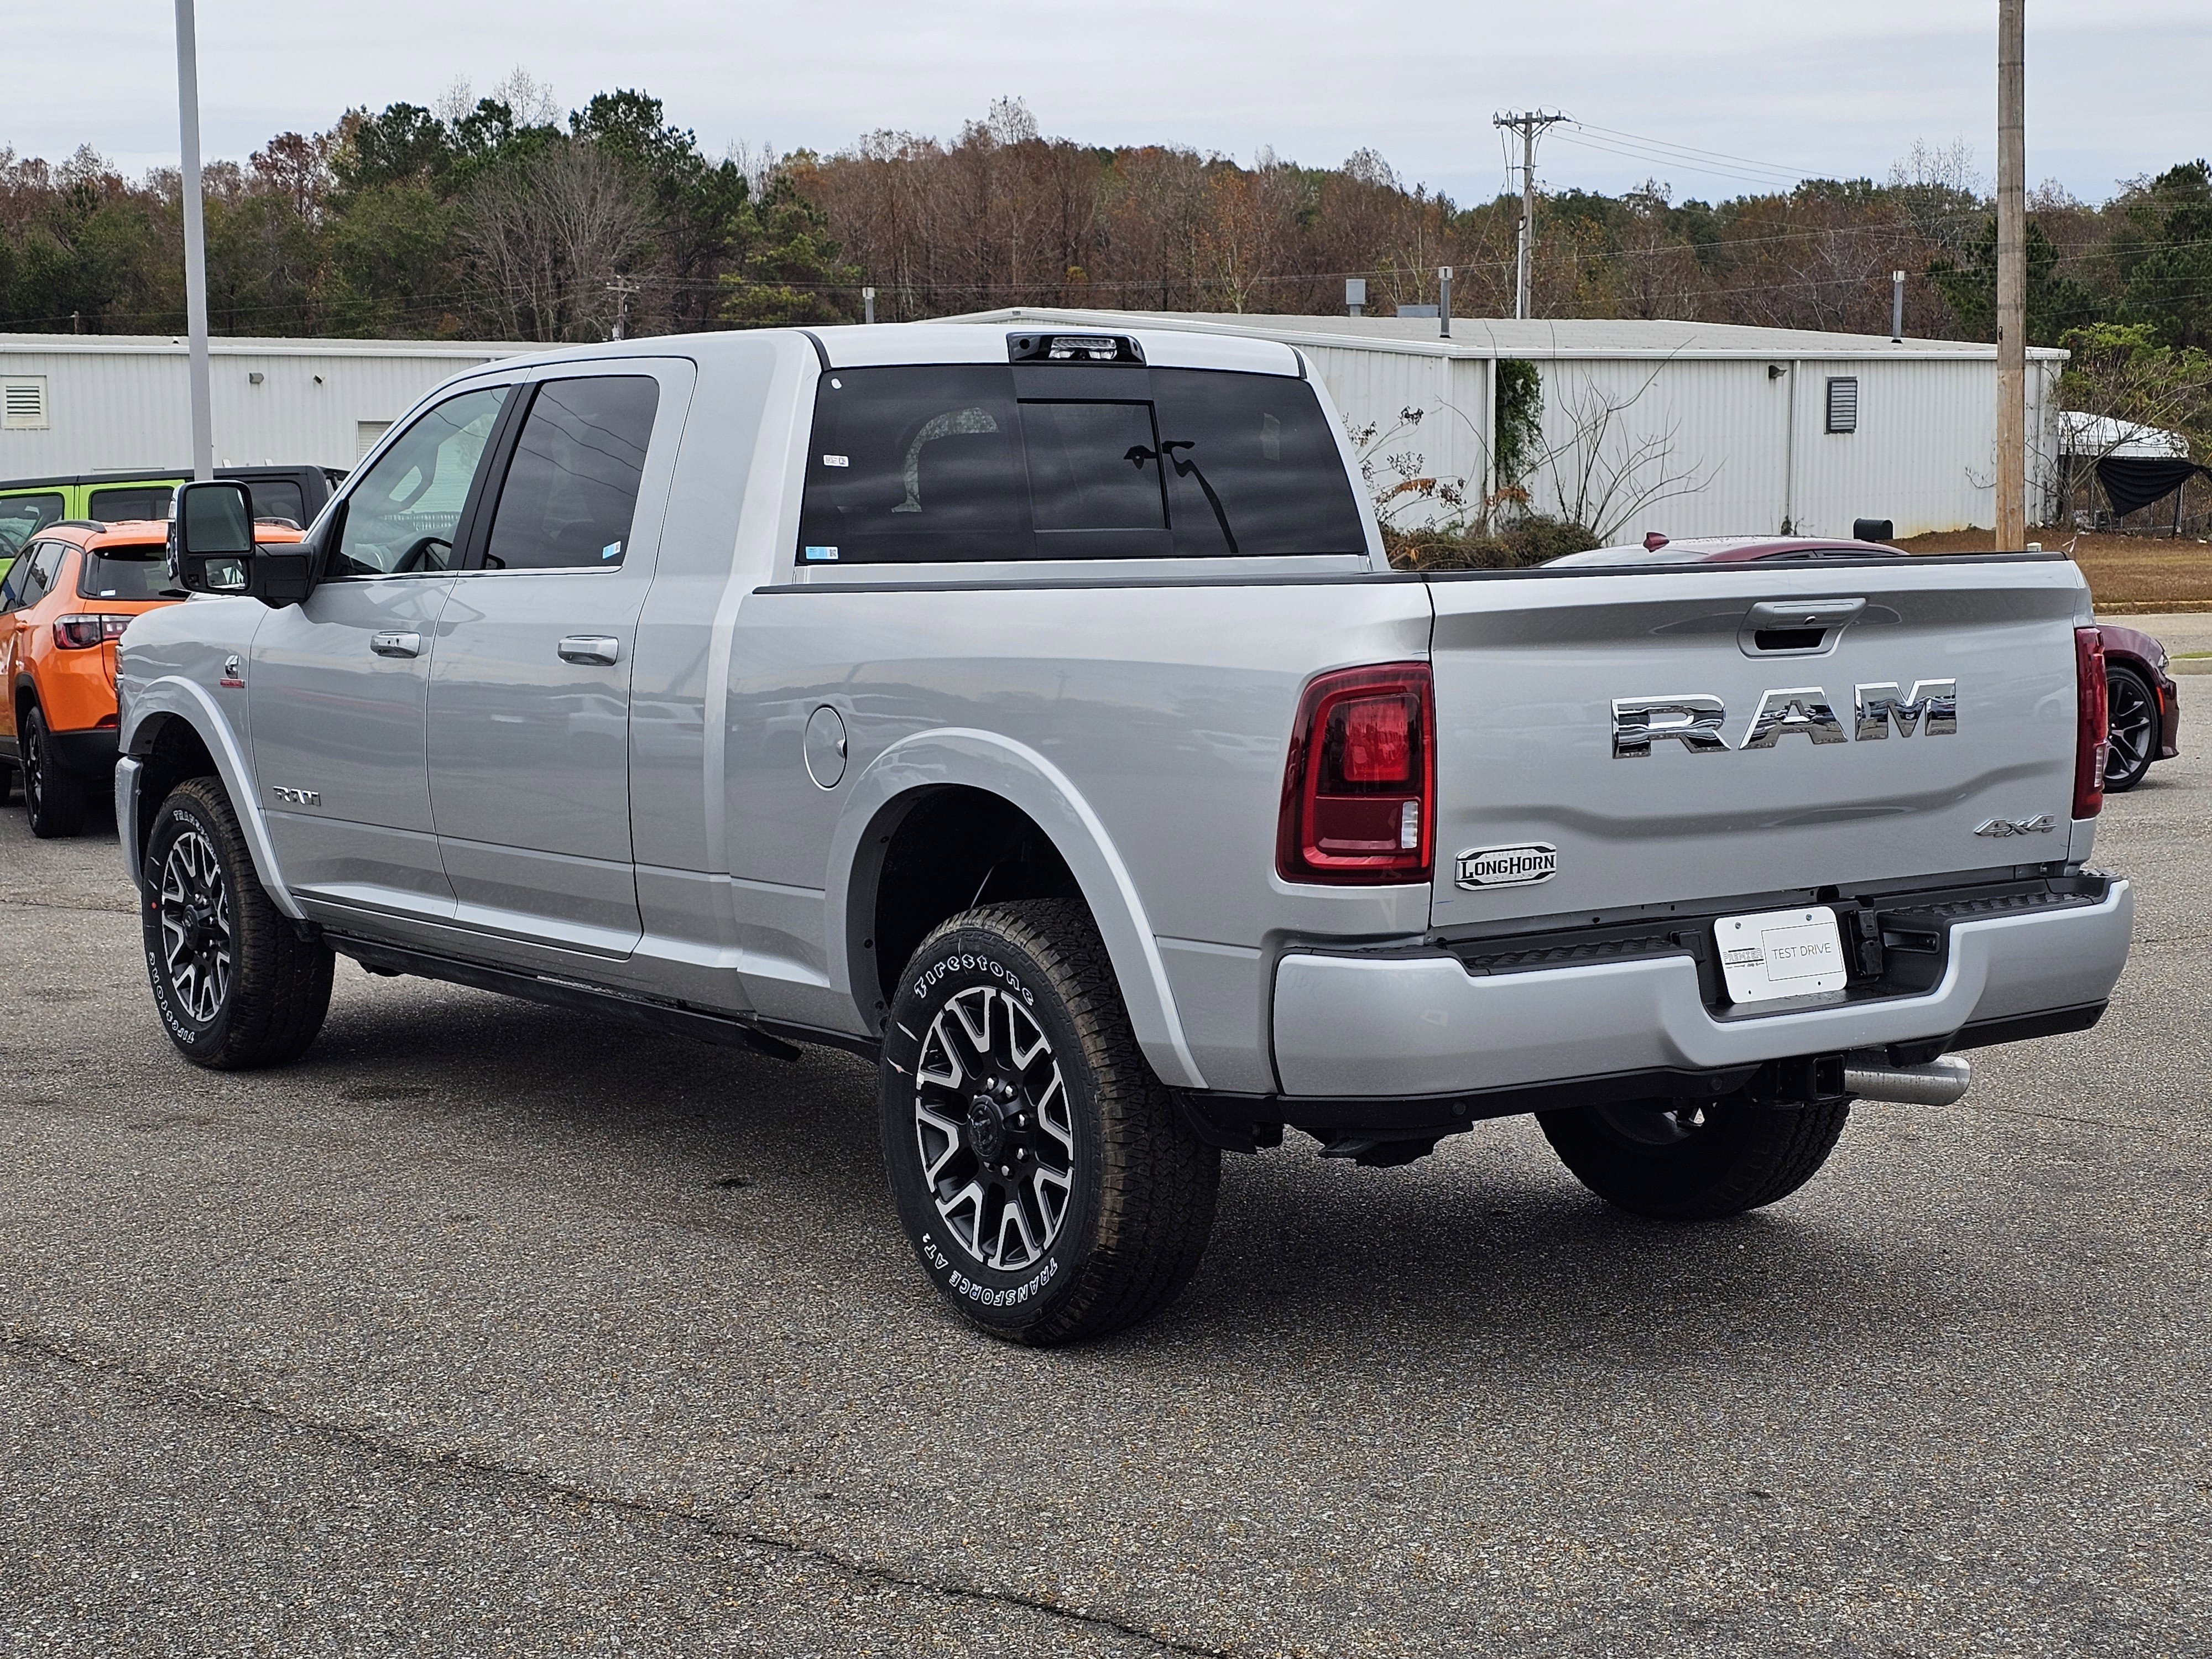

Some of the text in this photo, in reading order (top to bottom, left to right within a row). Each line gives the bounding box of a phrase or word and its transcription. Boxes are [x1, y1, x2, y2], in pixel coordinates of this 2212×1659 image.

[1611, 677, 1957, 759] RAM
[273, 785, 321, 806] RAM
[1771, 942, 1832, 959] TEST DRIVE
[914, 953, 1034, 1006] Firestone
[948, 1256, 1058, 1307] TRANSFORCE
